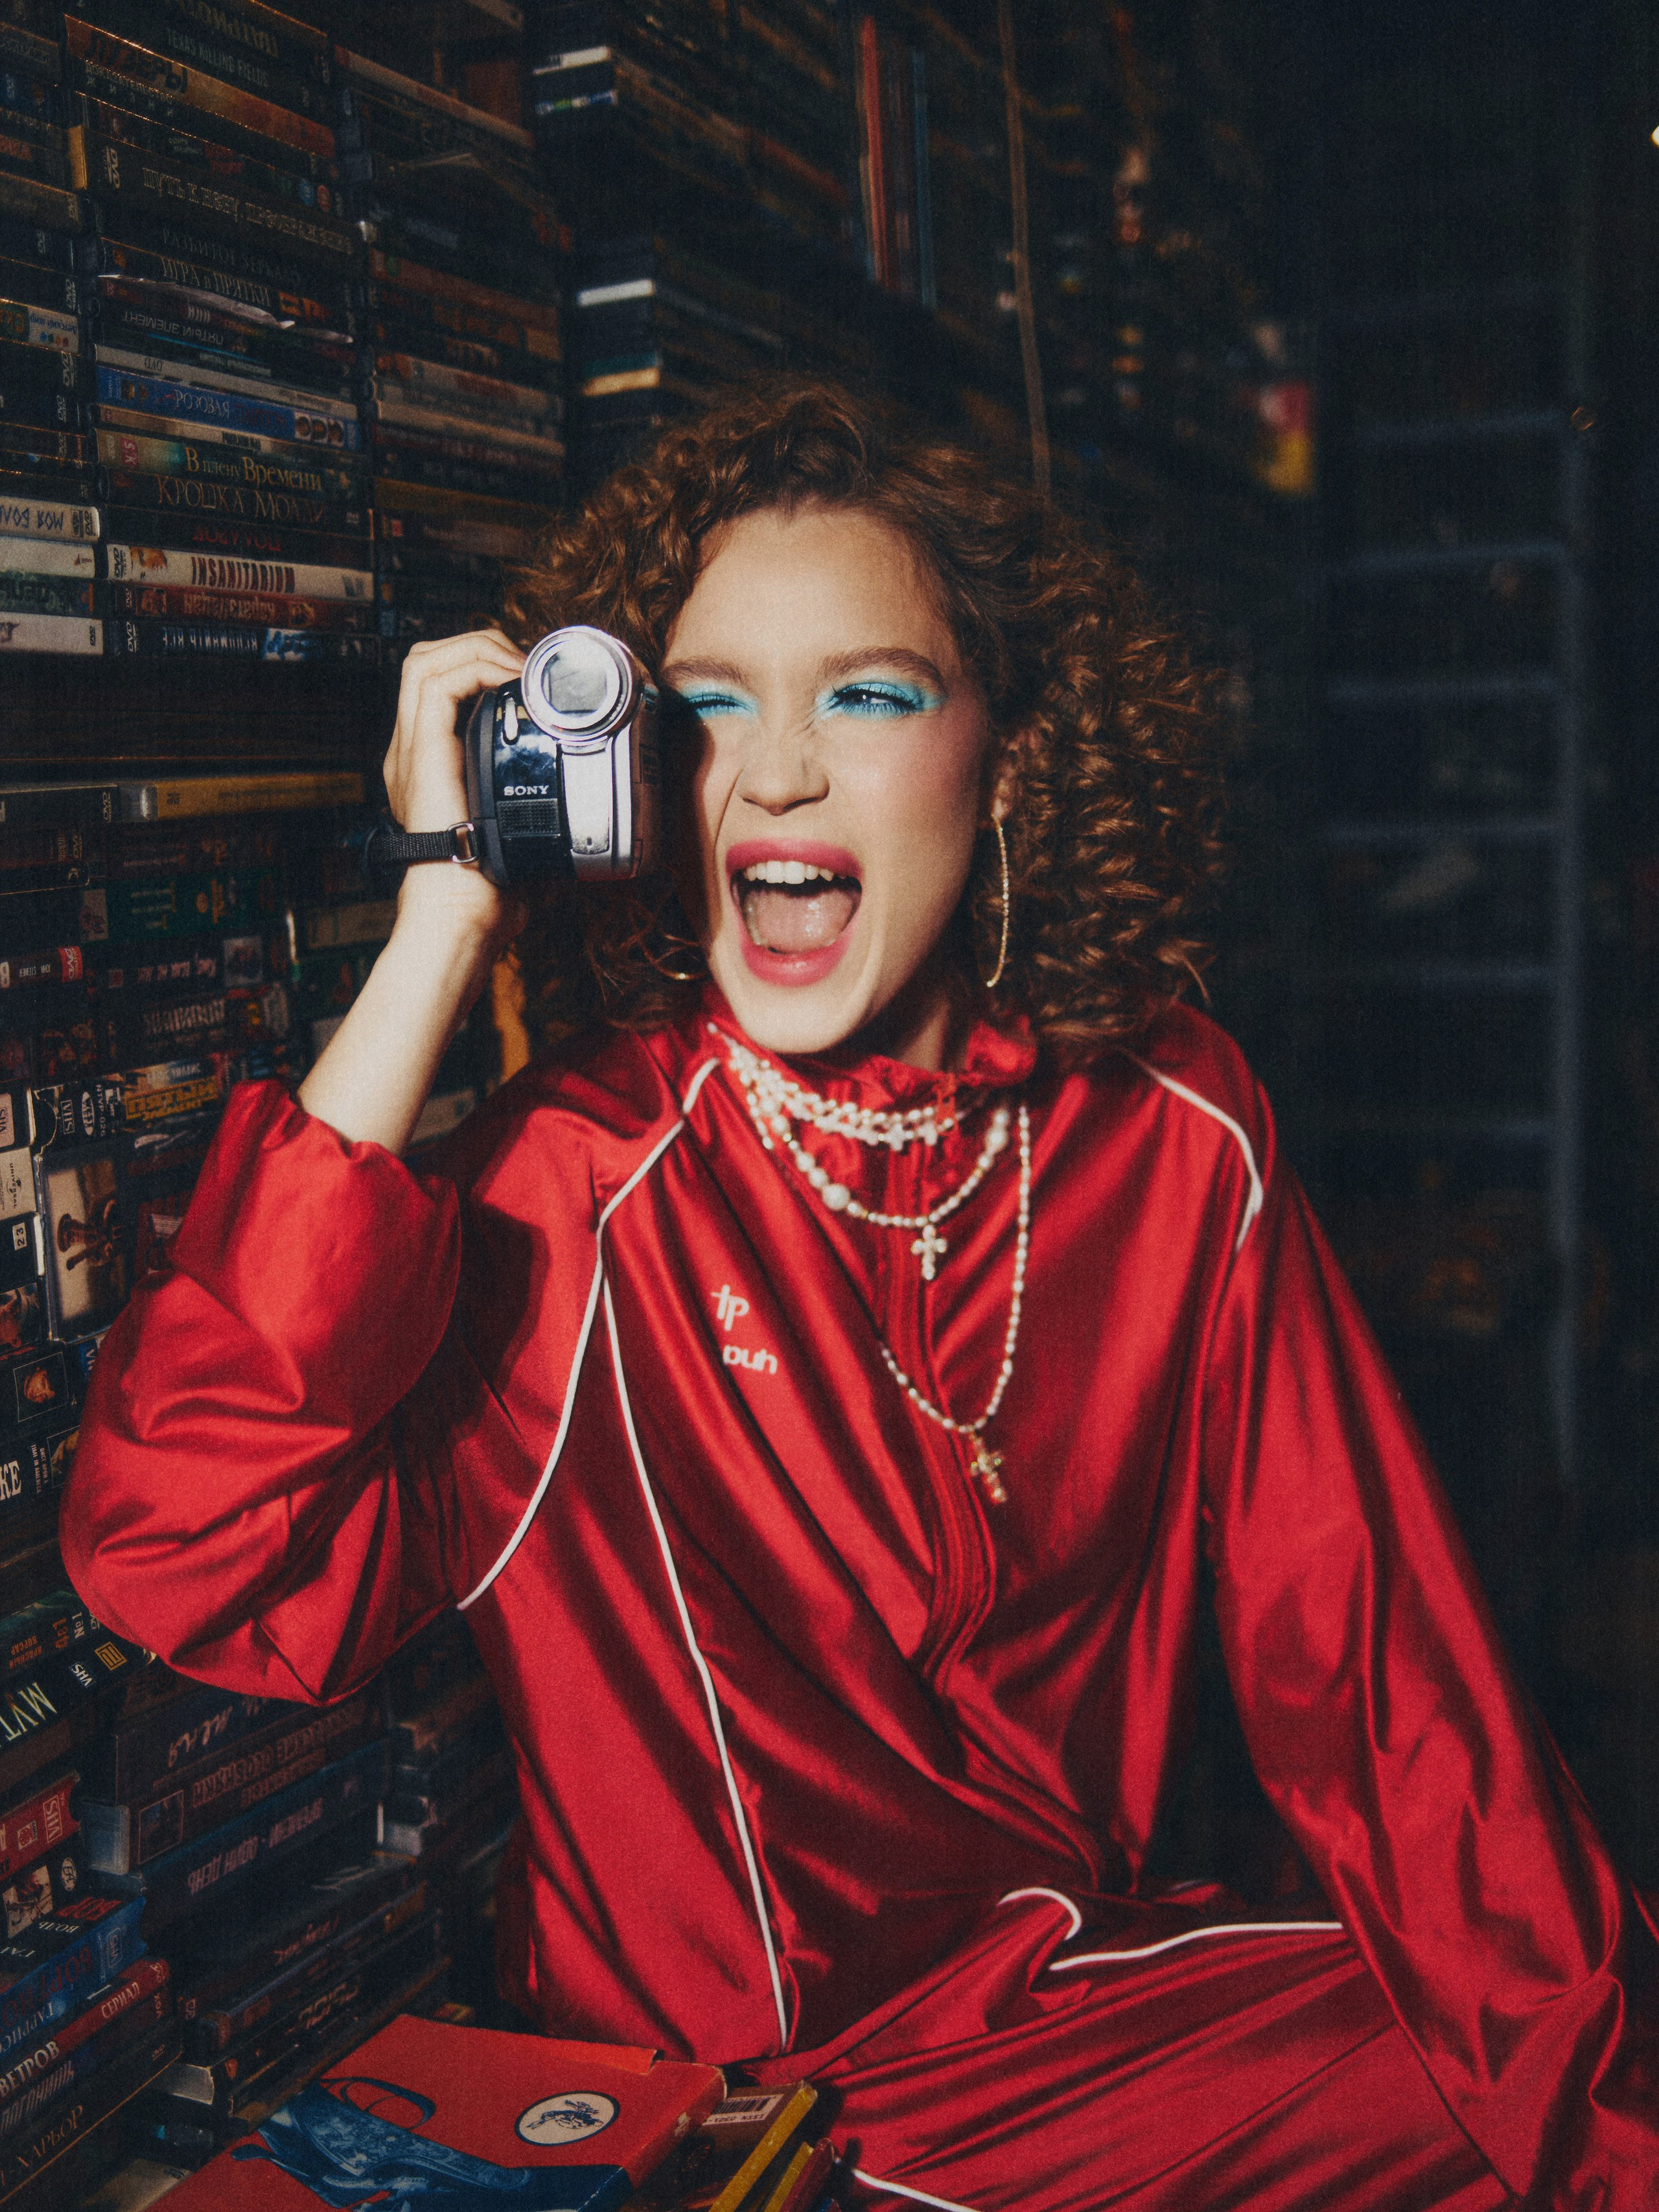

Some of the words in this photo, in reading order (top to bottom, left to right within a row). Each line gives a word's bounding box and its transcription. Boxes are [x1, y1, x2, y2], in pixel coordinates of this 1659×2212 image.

[167, 27, 194, 53] TEXAS
[198, 41, 234, 73] KILLING
[237, 58, 268, 87] FIELDS
[107, 146, 121, 190] DVD
[65, 278, 76, 312] DVD
[162, 256, 200, 286] ИГРА
[212, 271, 272, 308] ПРЯТКИ
[122, 310, 180, 333] ЭЛЕМЕНТ
[182, 325, 224, 346] ПЯТЫЙ
[56, 394, 67, 422] DVD
[174, 389, 230, 419] РОЗОВАЯ
[185, 447, 200, 472] В
[203, 461, 240, 478] плену
[243, 455, 322, 492] Времени
[157, 474, 244, 513] КРОШКА
[0, 505, 30, 529] БОЛ
[38, 511, 64, 531] МОЯ
[113, 547, 123, 578] DVD
[191, 556, 295, 594] INSANITARIUM
[126, 620, 138, 653] DVD
[102, 791, 113, 824] DVD
[504, 786, 549, 797] SONY
[130, 1080, 215, 1113] ПЯТЫЙ
[62, 1100, 75, 1134] VHS
[9, 1162, 18, 1209] UNIVERSAL
[17, 1226, 25, 1246] 23
[71, 1663, 93, 1687] VHS
[46, 1799, 60, 1843] VHS
[187, 1853, 222, 1895] ДЕНЬ
[55, 1896, 123, 1921] ВОР
[108, 1934, 121, 1966] VHS
[41, 1946, 92, 2001] БОРТ
[0, 1986, 34, 2027] НО
[101, 1981, 141, 2020] СЕРИАЛ
[0, 2001, 54, 2053] ГАРРИС
[0, 2040, 60, 2099] ВЕТРОВ
[741, 2113, 765, 2122] ISSN
